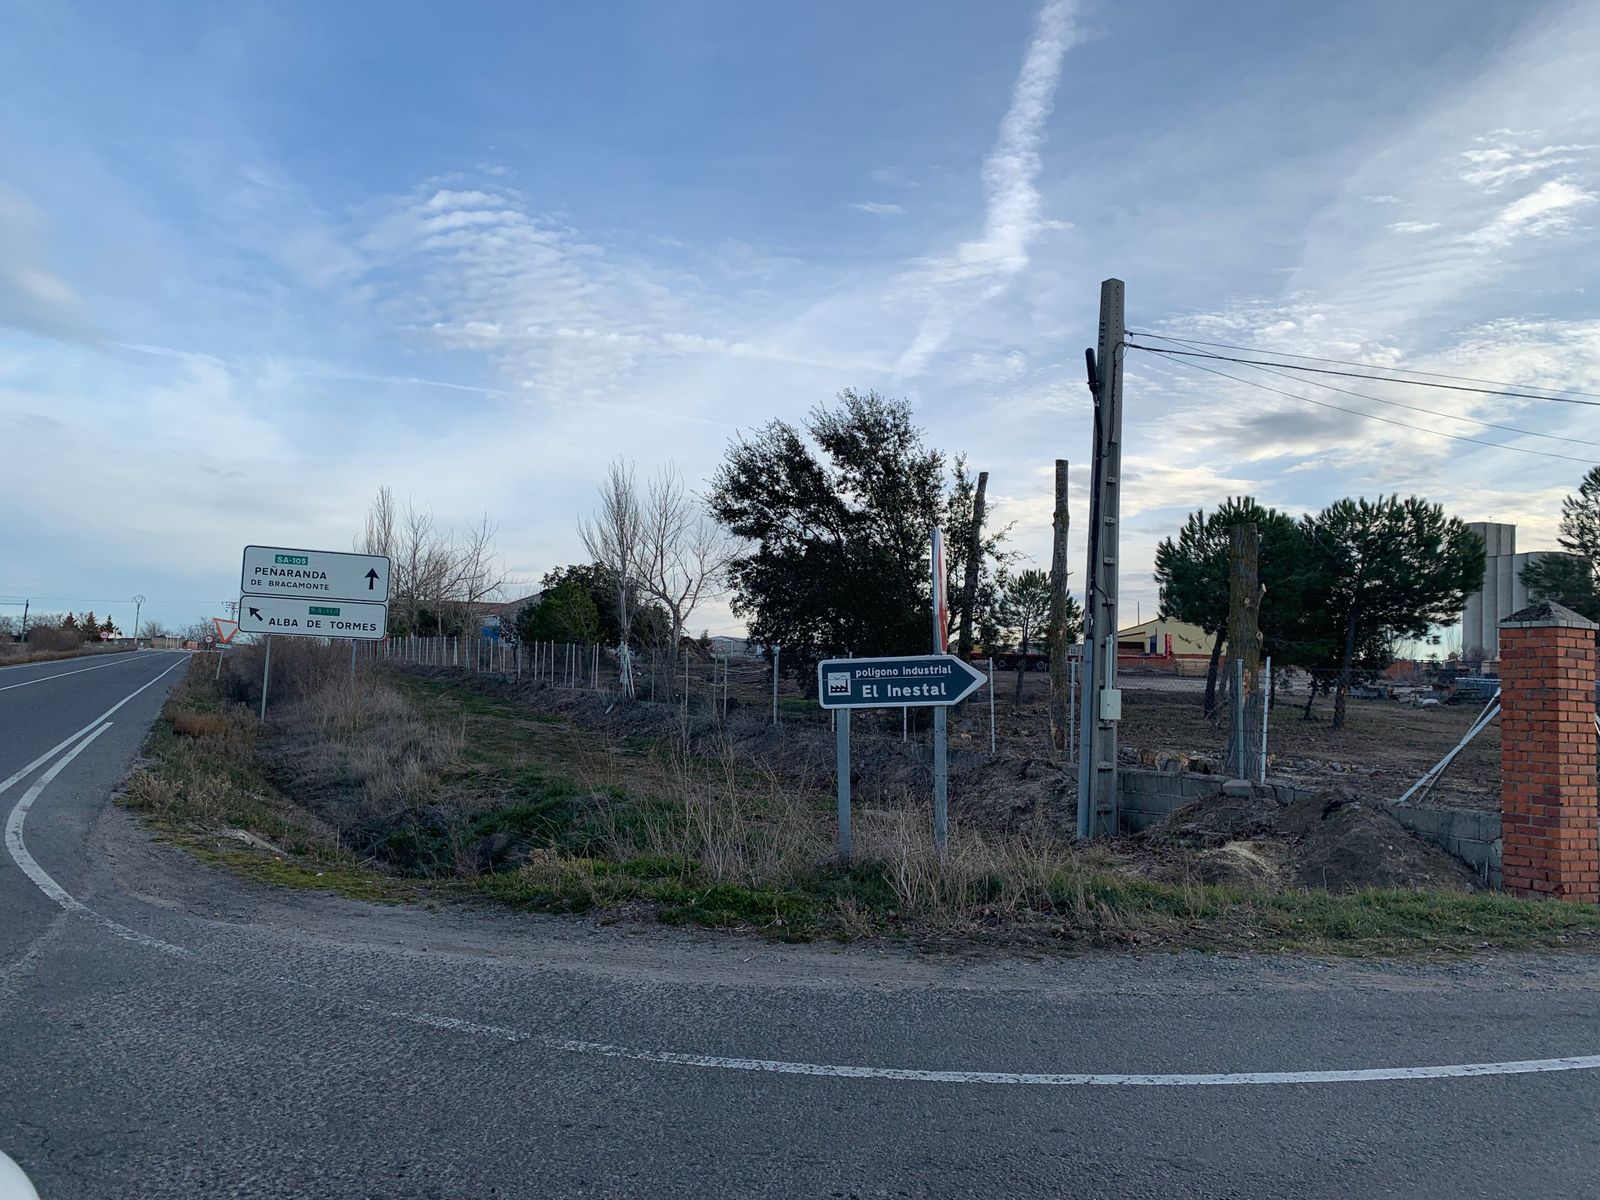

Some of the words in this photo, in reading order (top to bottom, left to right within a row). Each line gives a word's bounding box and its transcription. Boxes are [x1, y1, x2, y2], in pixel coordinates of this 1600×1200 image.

[277, 556, 307, 565] SA-105
[254, 565, 327, 580] PEÑARANDA
[268, 580, 330, 591] BRACAMONTE
[268, 617, 299, 627] ALBA
[306, 619, 322, 628] DE
[329, 621, 377, 631] TORMES
[855, 666, 899, 679] polígono
[902, 665, 952, 675] industrial
[862, 684, 879, 698] El
[887, 683, 947, 697] Inestal
